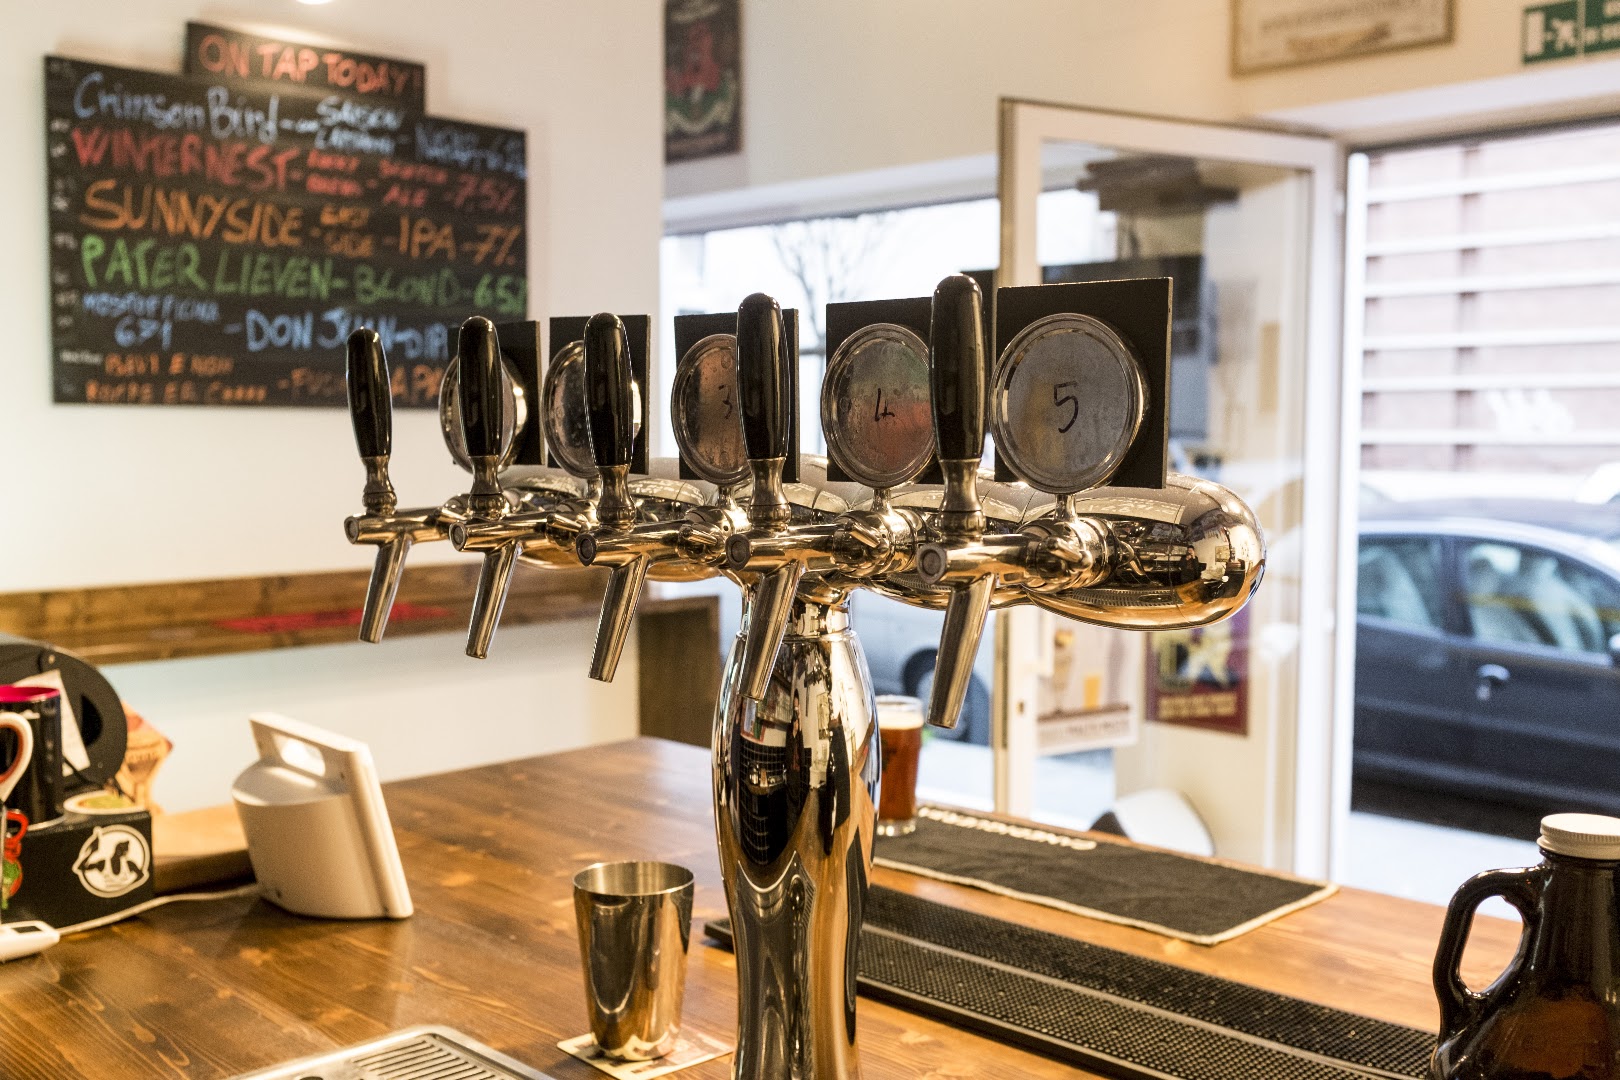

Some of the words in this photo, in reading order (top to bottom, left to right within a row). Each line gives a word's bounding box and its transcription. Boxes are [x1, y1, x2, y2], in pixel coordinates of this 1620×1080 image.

[199, 34, 249, 79] ON
[256, 43, 319, 82] TAP
[80, 179, 304, 247] SUNNYSIDE
[81, 234, 210, 290] PATER
[245, 307, 313, 351] DON
[874, 388, 896, 422] 4
[1053, 380, 1080, 434] 5
